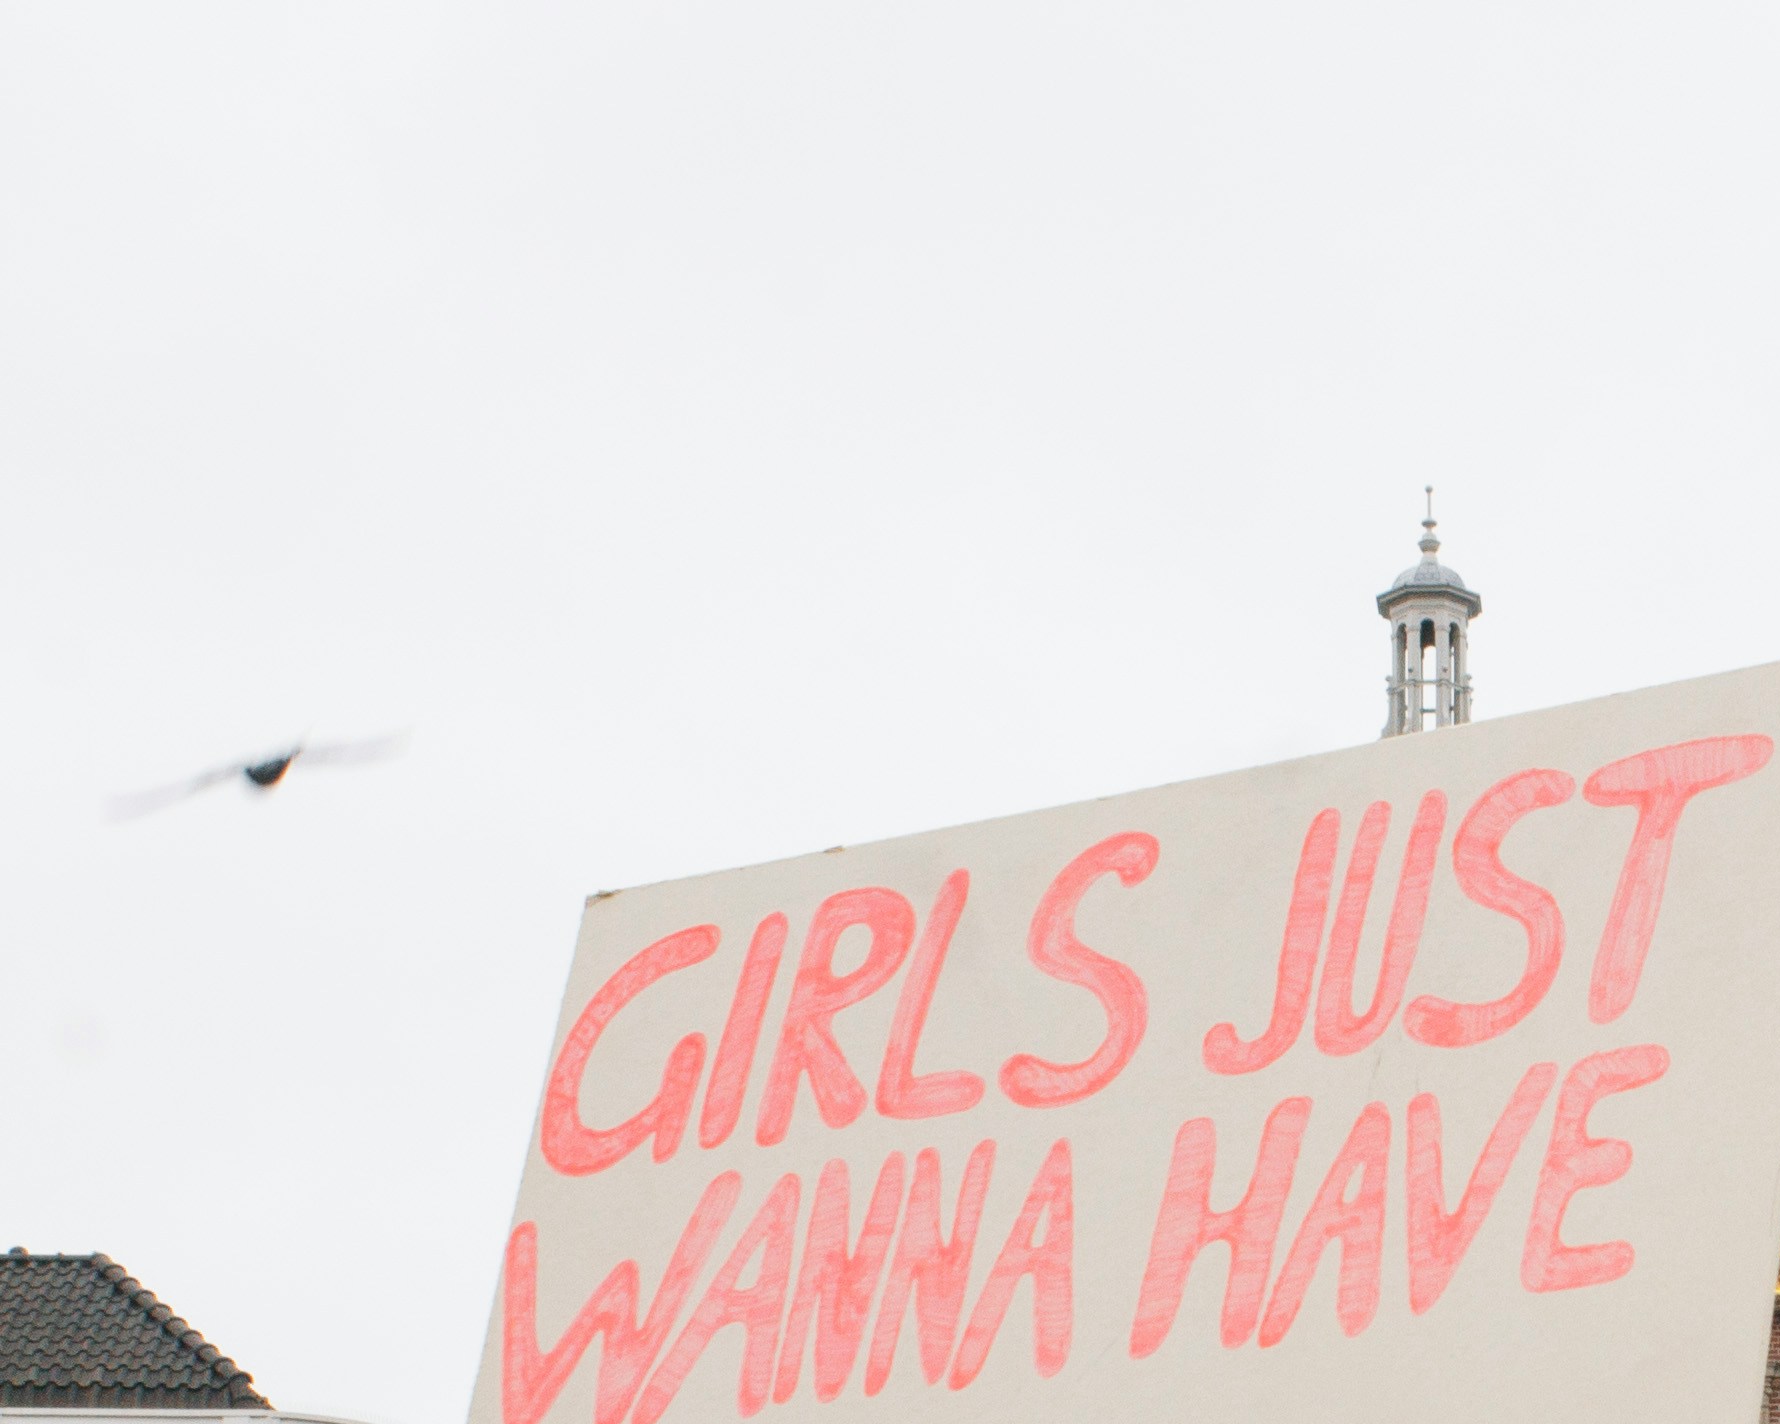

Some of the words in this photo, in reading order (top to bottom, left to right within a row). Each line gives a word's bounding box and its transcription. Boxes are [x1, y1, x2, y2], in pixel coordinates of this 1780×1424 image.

[539, 830, 1161, 1178] GIRLS
[1202, 733, 1774, 1076] JUST
[1129, 1043, 1671, 1360] HAVE
